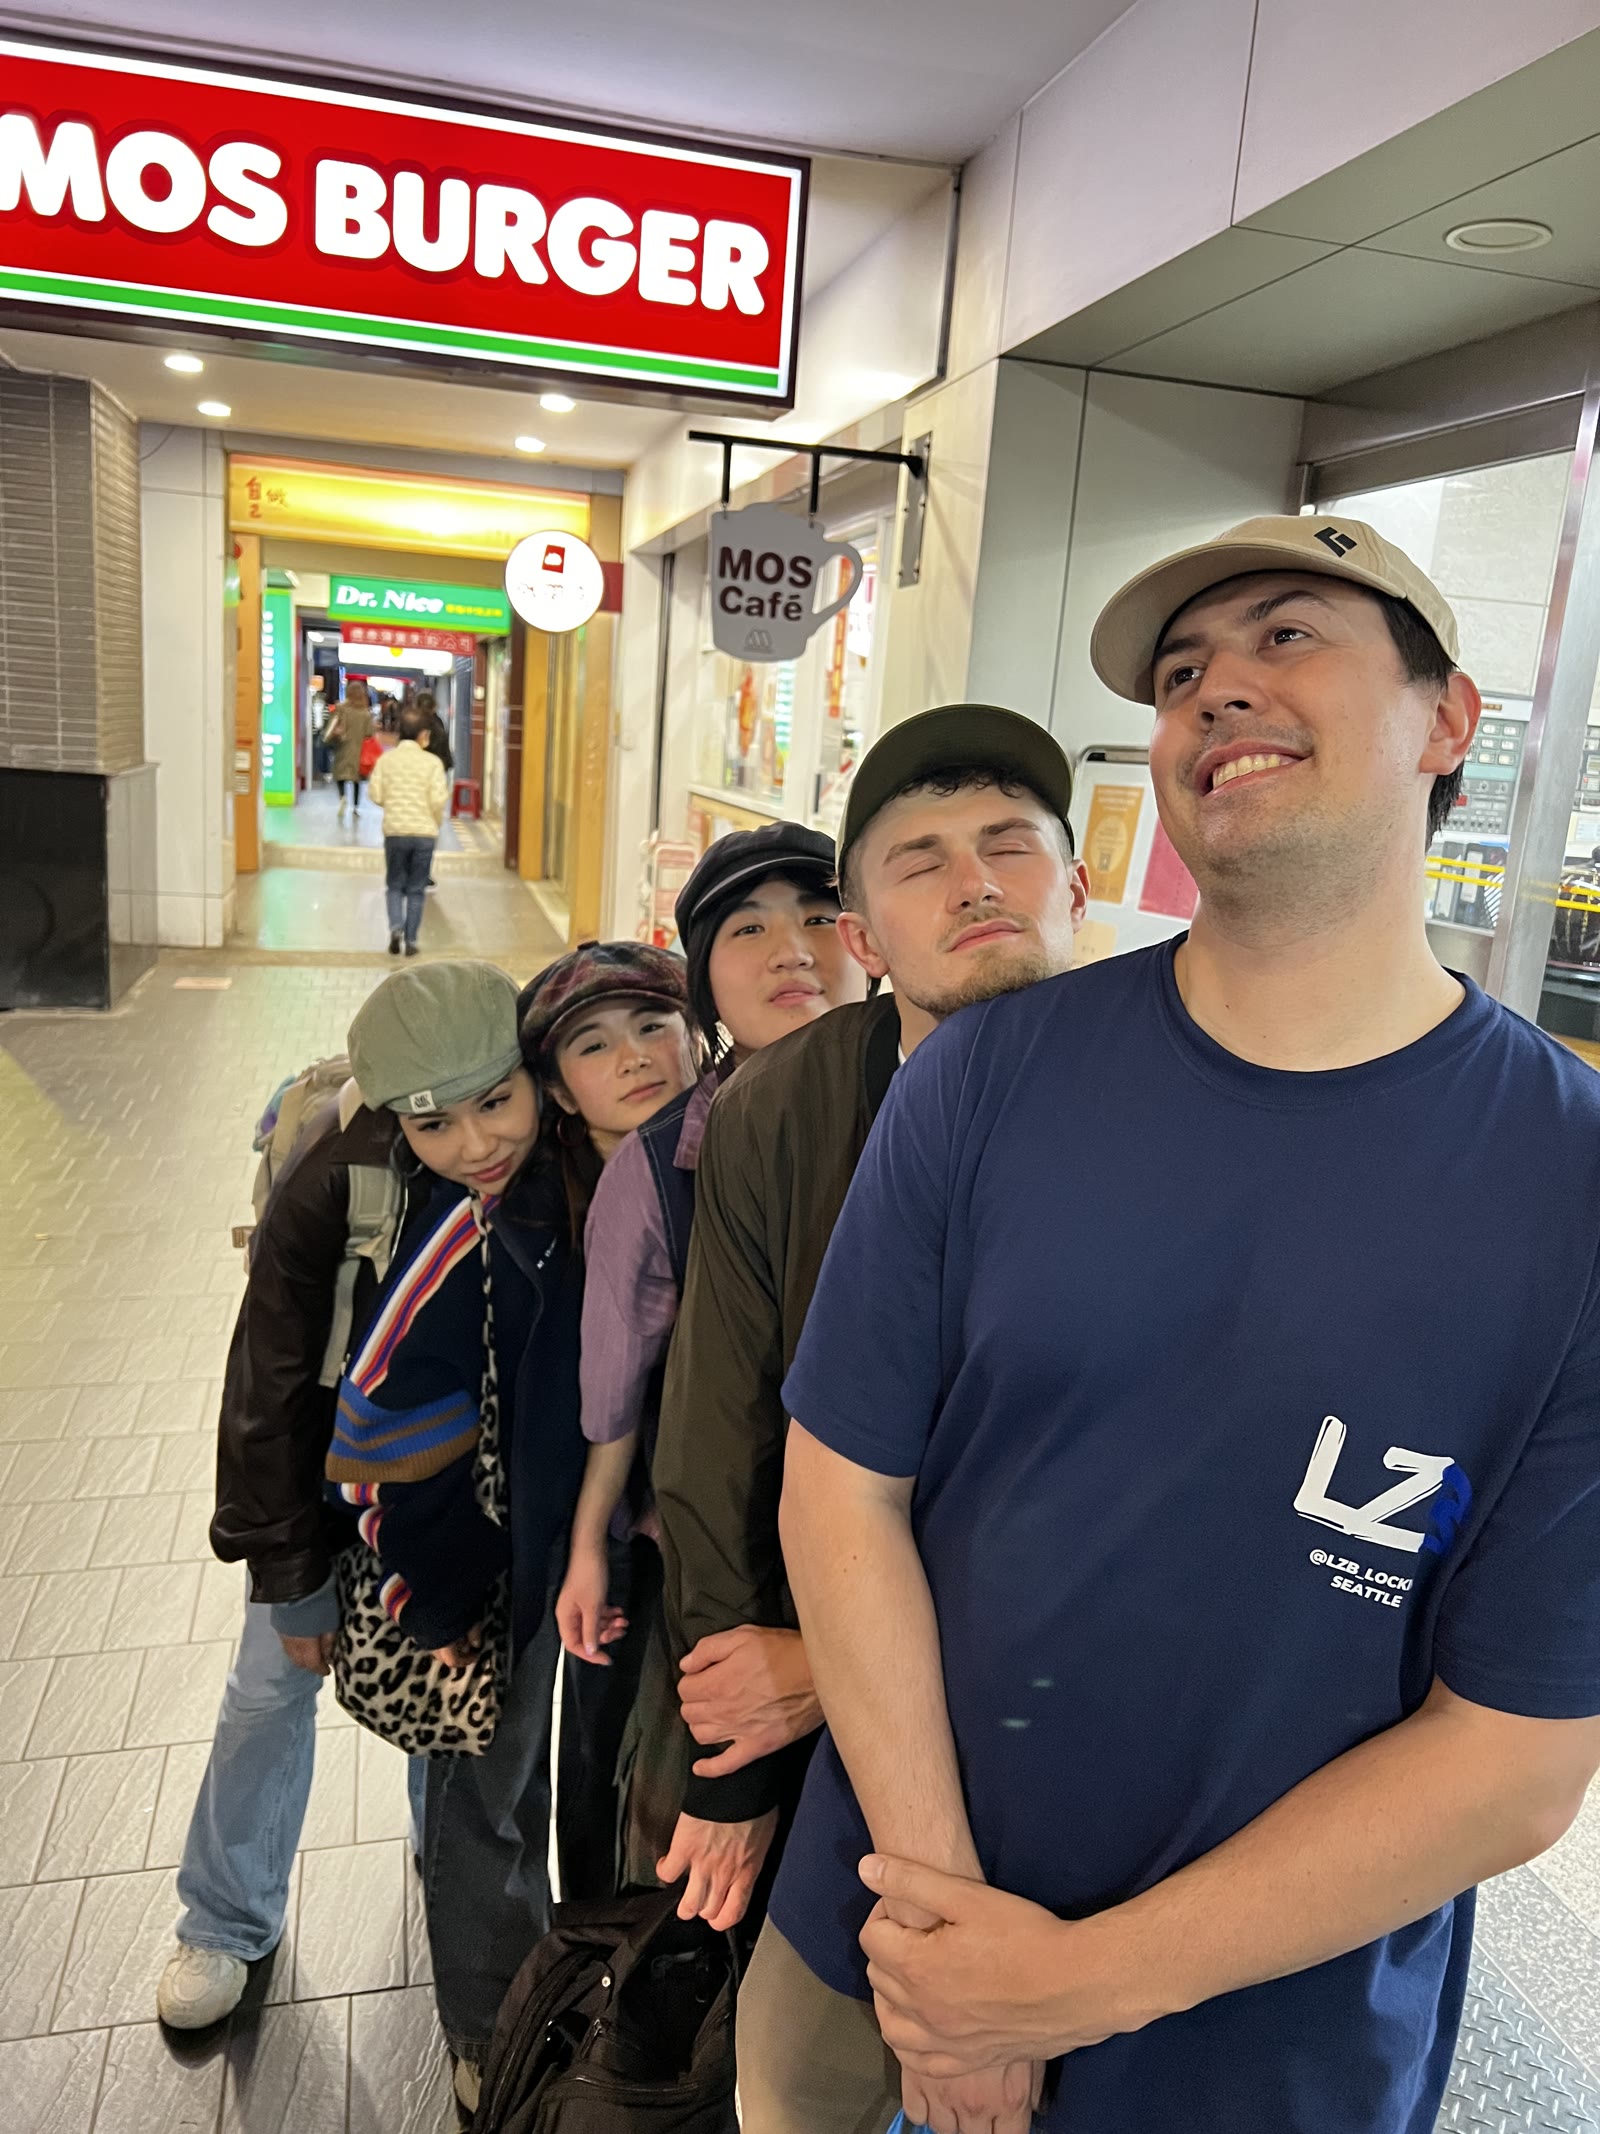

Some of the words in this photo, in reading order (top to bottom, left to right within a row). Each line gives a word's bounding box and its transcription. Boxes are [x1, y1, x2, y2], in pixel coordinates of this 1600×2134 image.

[0, 113, 288, 247] MOS
[315, 159, 770, 316] BURGER
[719, 546, 812, 589] MOS
[336, 585, 378, 608] Dr.
[719, 585, 803, 621] Café
[1330, 1575, 1404, 1609] SEATTLE
